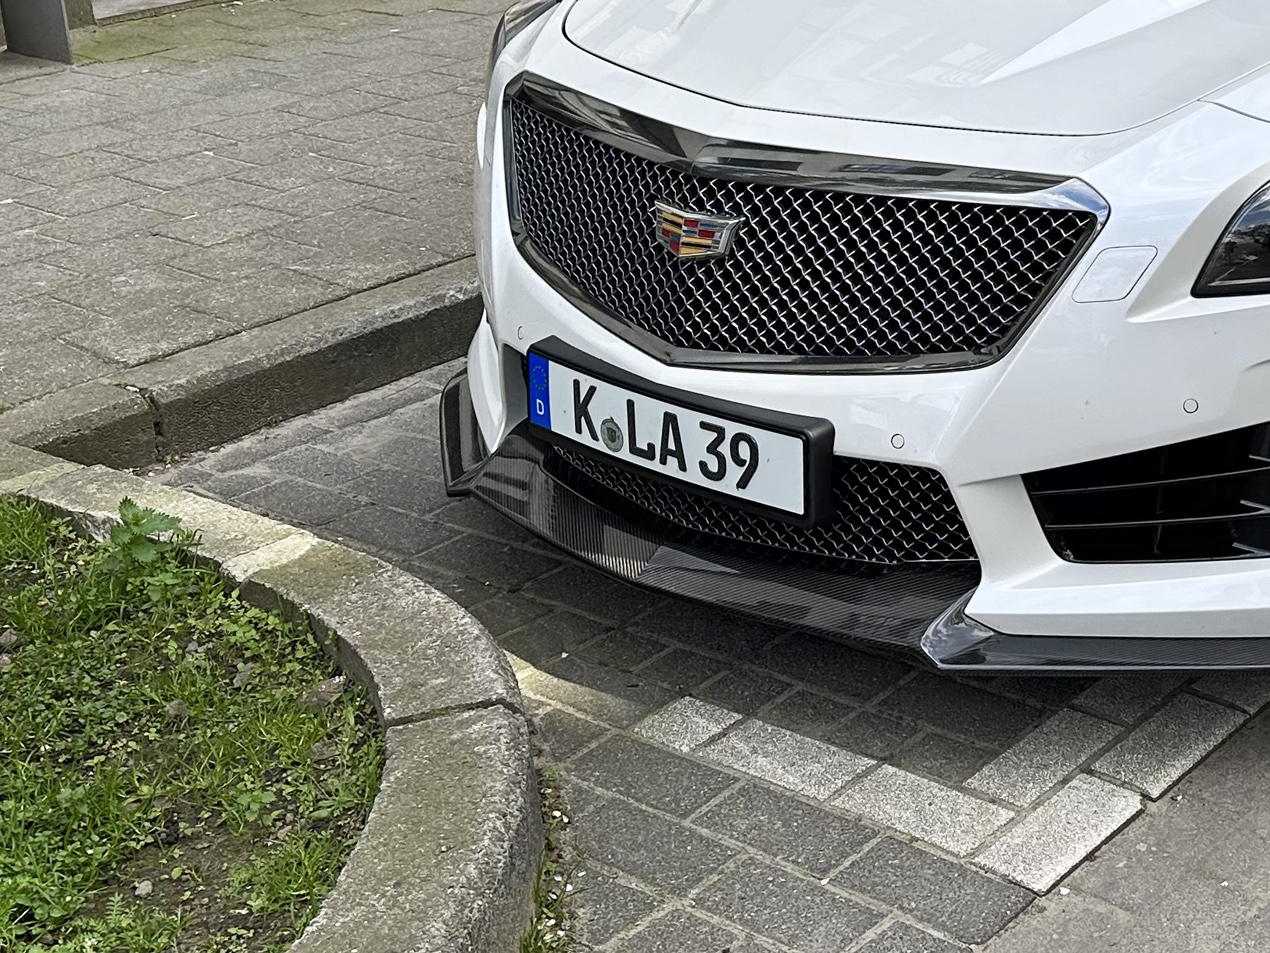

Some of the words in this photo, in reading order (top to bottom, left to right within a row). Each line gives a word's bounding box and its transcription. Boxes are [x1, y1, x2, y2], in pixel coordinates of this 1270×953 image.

[536, 398, 545, 416] D
[573, 379, 599, 442] K
[626, 398, 688, 472] LA
[699, 420, 759, 490] 39
